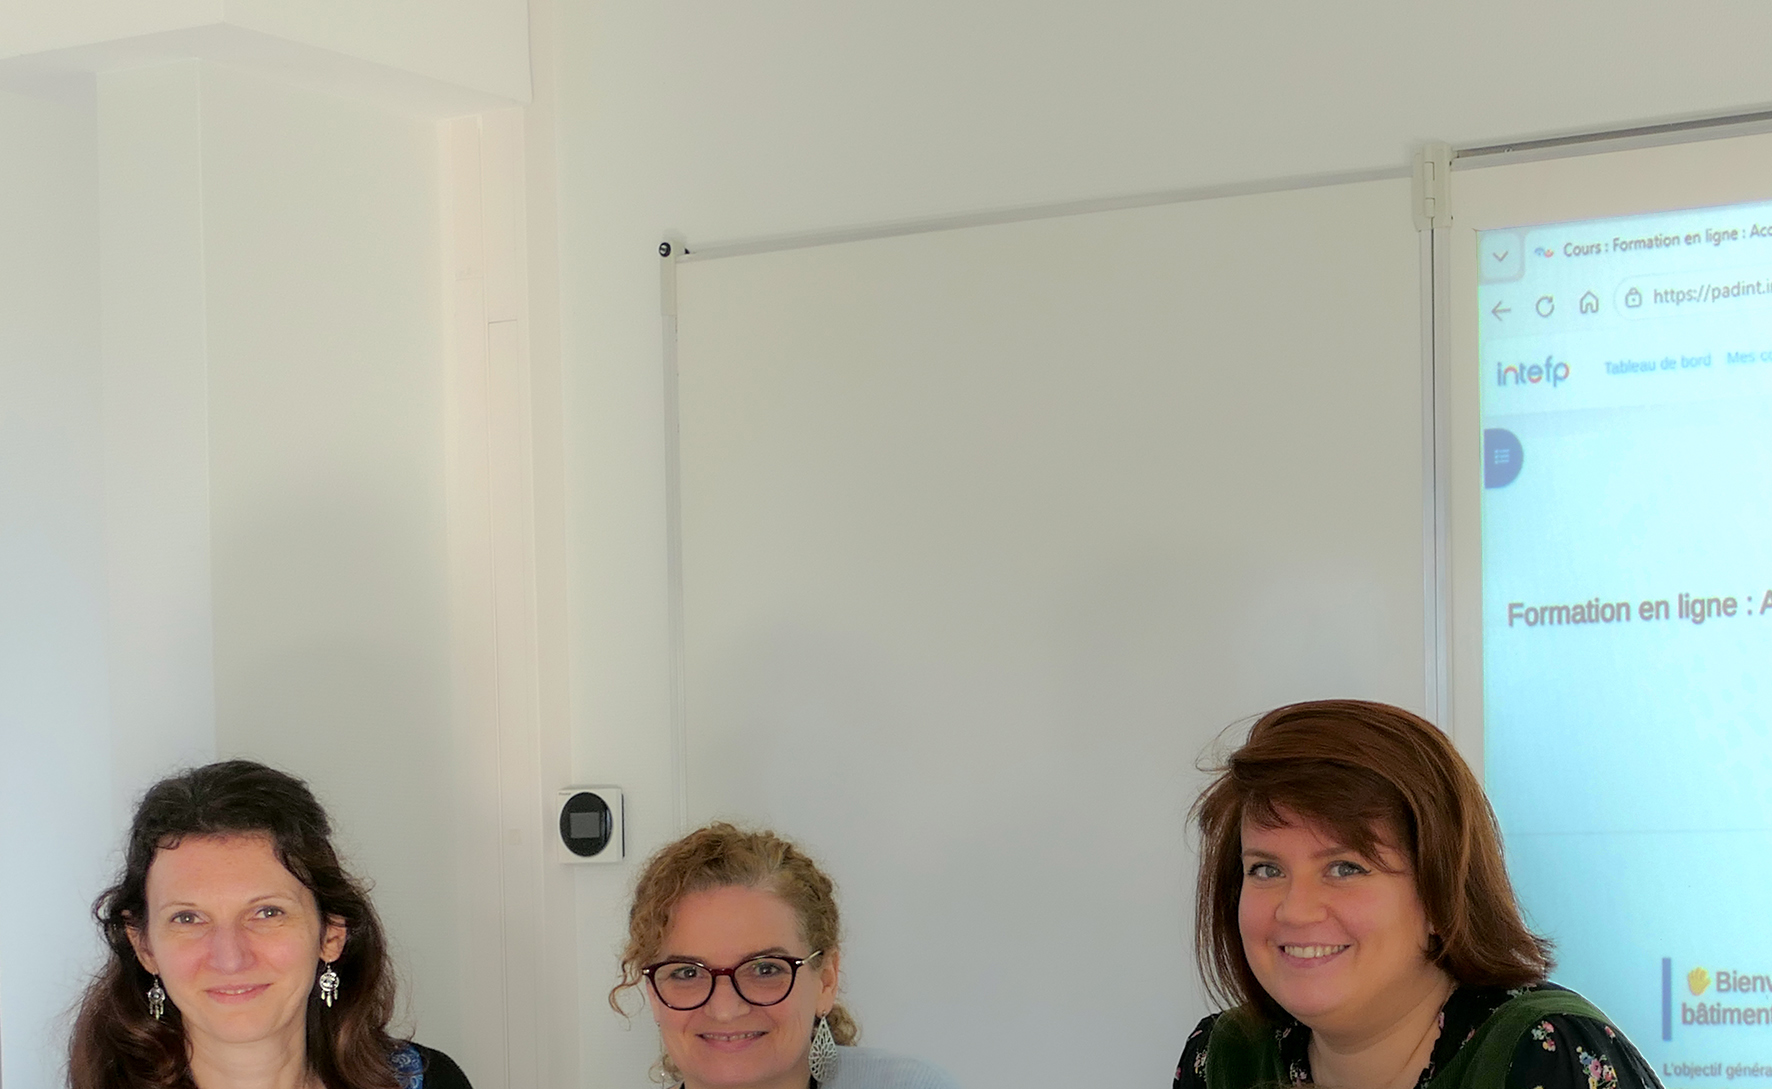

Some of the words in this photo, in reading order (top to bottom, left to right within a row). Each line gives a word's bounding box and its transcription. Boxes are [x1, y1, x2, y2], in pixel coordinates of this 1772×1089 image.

[1563, 242, 1601, 257] Cours
[1612, 234, 1680, 251] Formation
[1684, 233, 1701, 246] en
[1705, 228, 1739, 247] ligne
[1605, 359, 1656, 376] Tableau
[1660, 356, 1676, 371] de
[1681, 353, 1712, 368] bord
[1727, 350, 1756, 365] Mes
[1497, 355, 1571, 388] intefp
[1506, 597, 1632, 628] Formation
[1638, 600, 1670, 621] en
[1677, 592, 1738, 624] ligne
[1662, 1062, 1723, 1080] L'objectif
